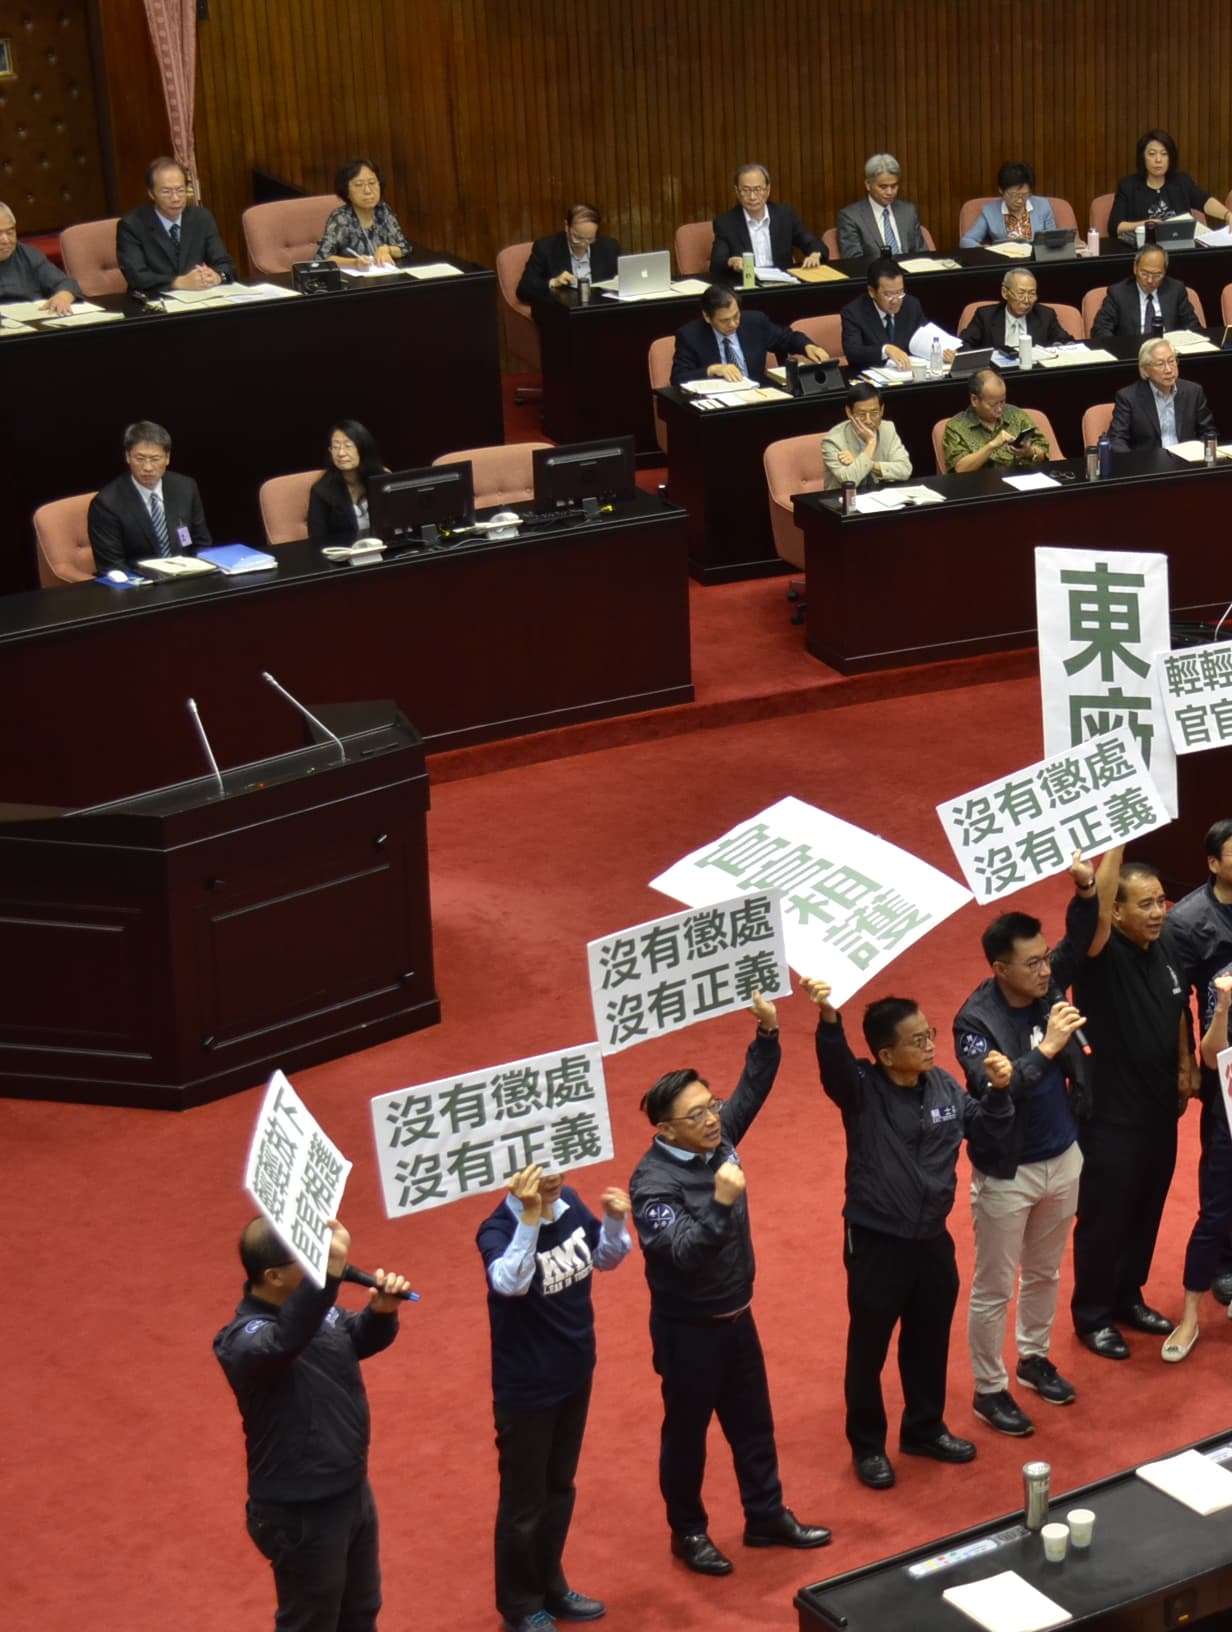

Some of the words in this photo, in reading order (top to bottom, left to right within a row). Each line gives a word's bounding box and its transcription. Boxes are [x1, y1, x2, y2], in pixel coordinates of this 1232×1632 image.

[951, 737, 1137, 847] 沒有懲處
[973, 786, 1157, 895] 沒有正義
[599, 896, 775, 990] 沒有懲處
[693, 823, 933, 971] 官官相護
[606, 950, 781, 1045] 沒有正義
[386, 1054, 596, 1149] 沒有懲處
[394, 1111, 602, 1208] 沒有正義
